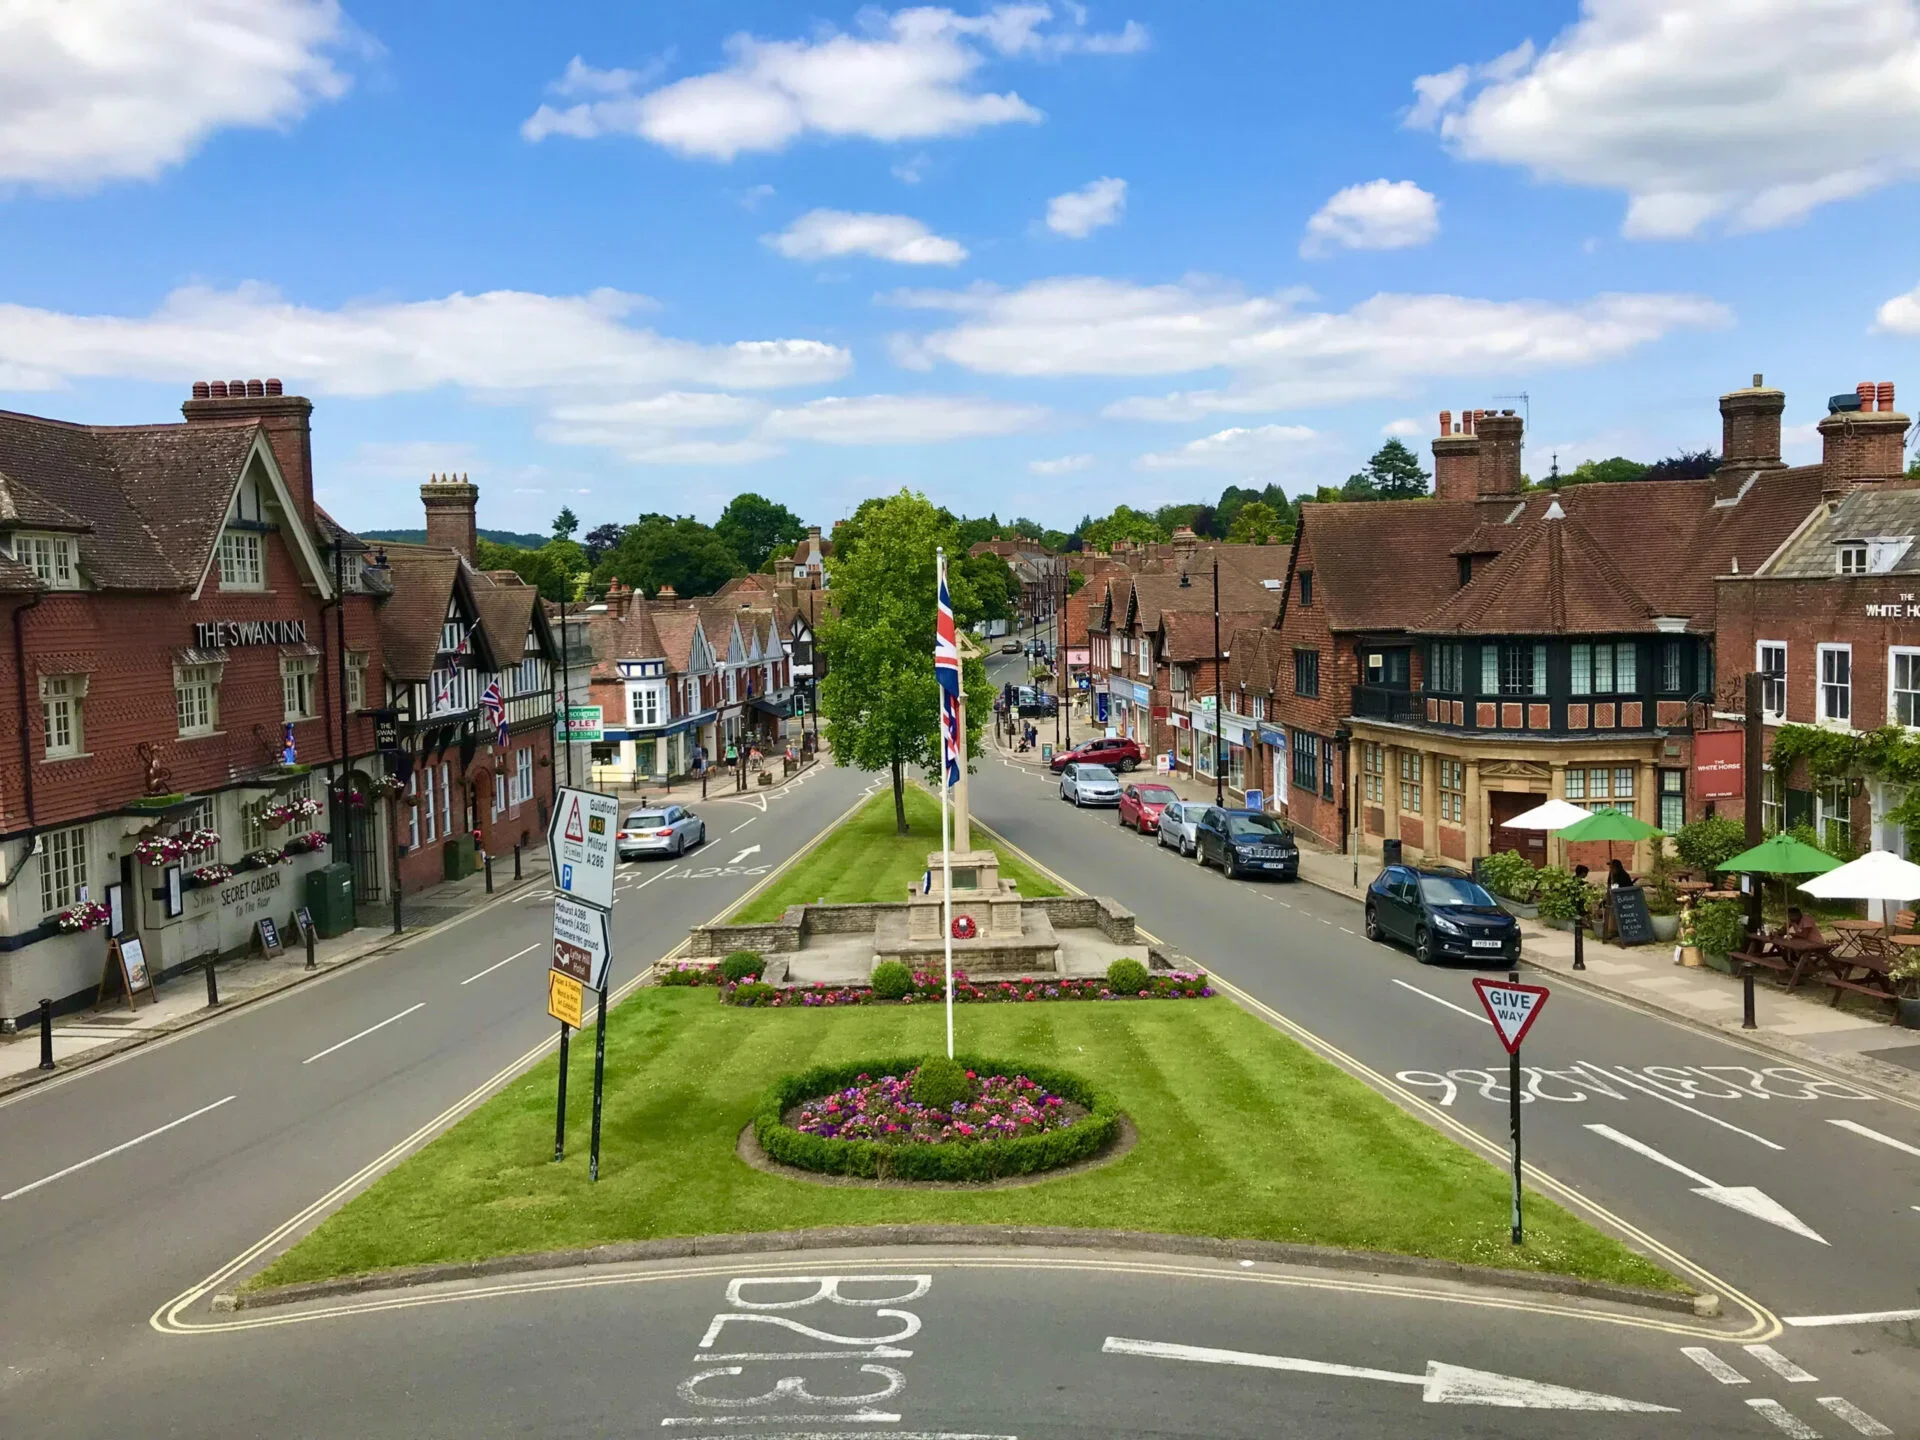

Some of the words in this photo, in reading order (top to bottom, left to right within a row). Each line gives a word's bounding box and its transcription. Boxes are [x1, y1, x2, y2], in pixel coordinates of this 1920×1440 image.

[1899, 593, 1915, 601] THE
[1865, 604, 1902, 617] WHITE
[196, 622, 225, 648] THE
[228, 620, 277, 646] SWAN
[280, 620, 306, 643] INN
[590, 799, 616, 815] Guildford
[587, 836, 608, 852] Milford
[563, 867, 571, 888] P
[665, 864, 773, 880] A286
[221, 881, 250, 906] SECRET
[251, 871, 280, 895] GARDEN
[1490, 991, 1531, 1009] GIVE
[1498, 1009, 1524, 1022] WAY
[1396, 1066, 1628, 1106] A286
